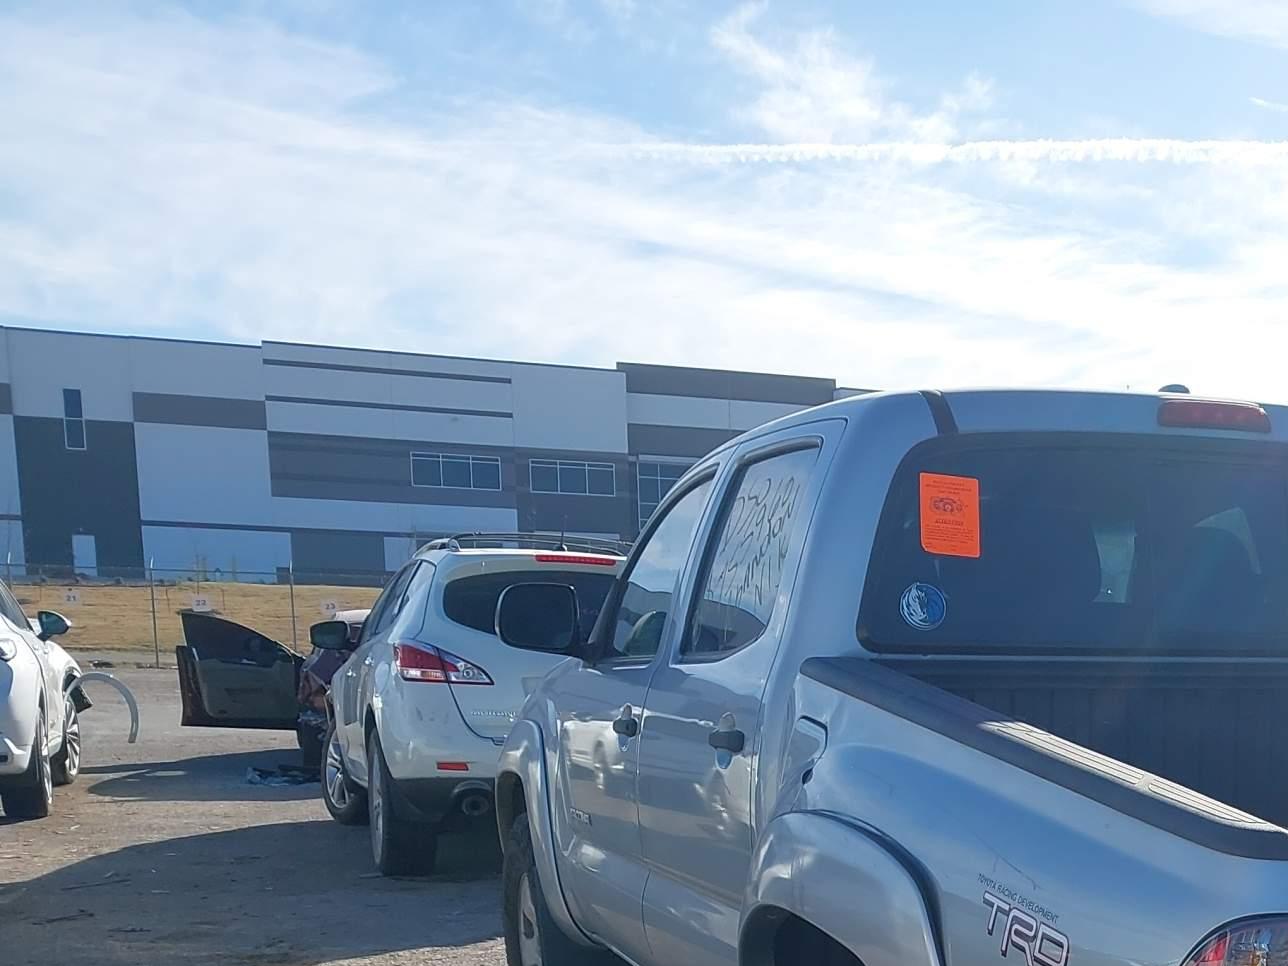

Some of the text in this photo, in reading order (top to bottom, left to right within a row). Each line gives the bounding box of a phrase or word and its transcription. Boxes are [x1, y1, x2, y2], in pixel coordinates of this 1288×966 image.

[978, 872, 1060, 924] TOYOTA RACING DEVELOPMENT
